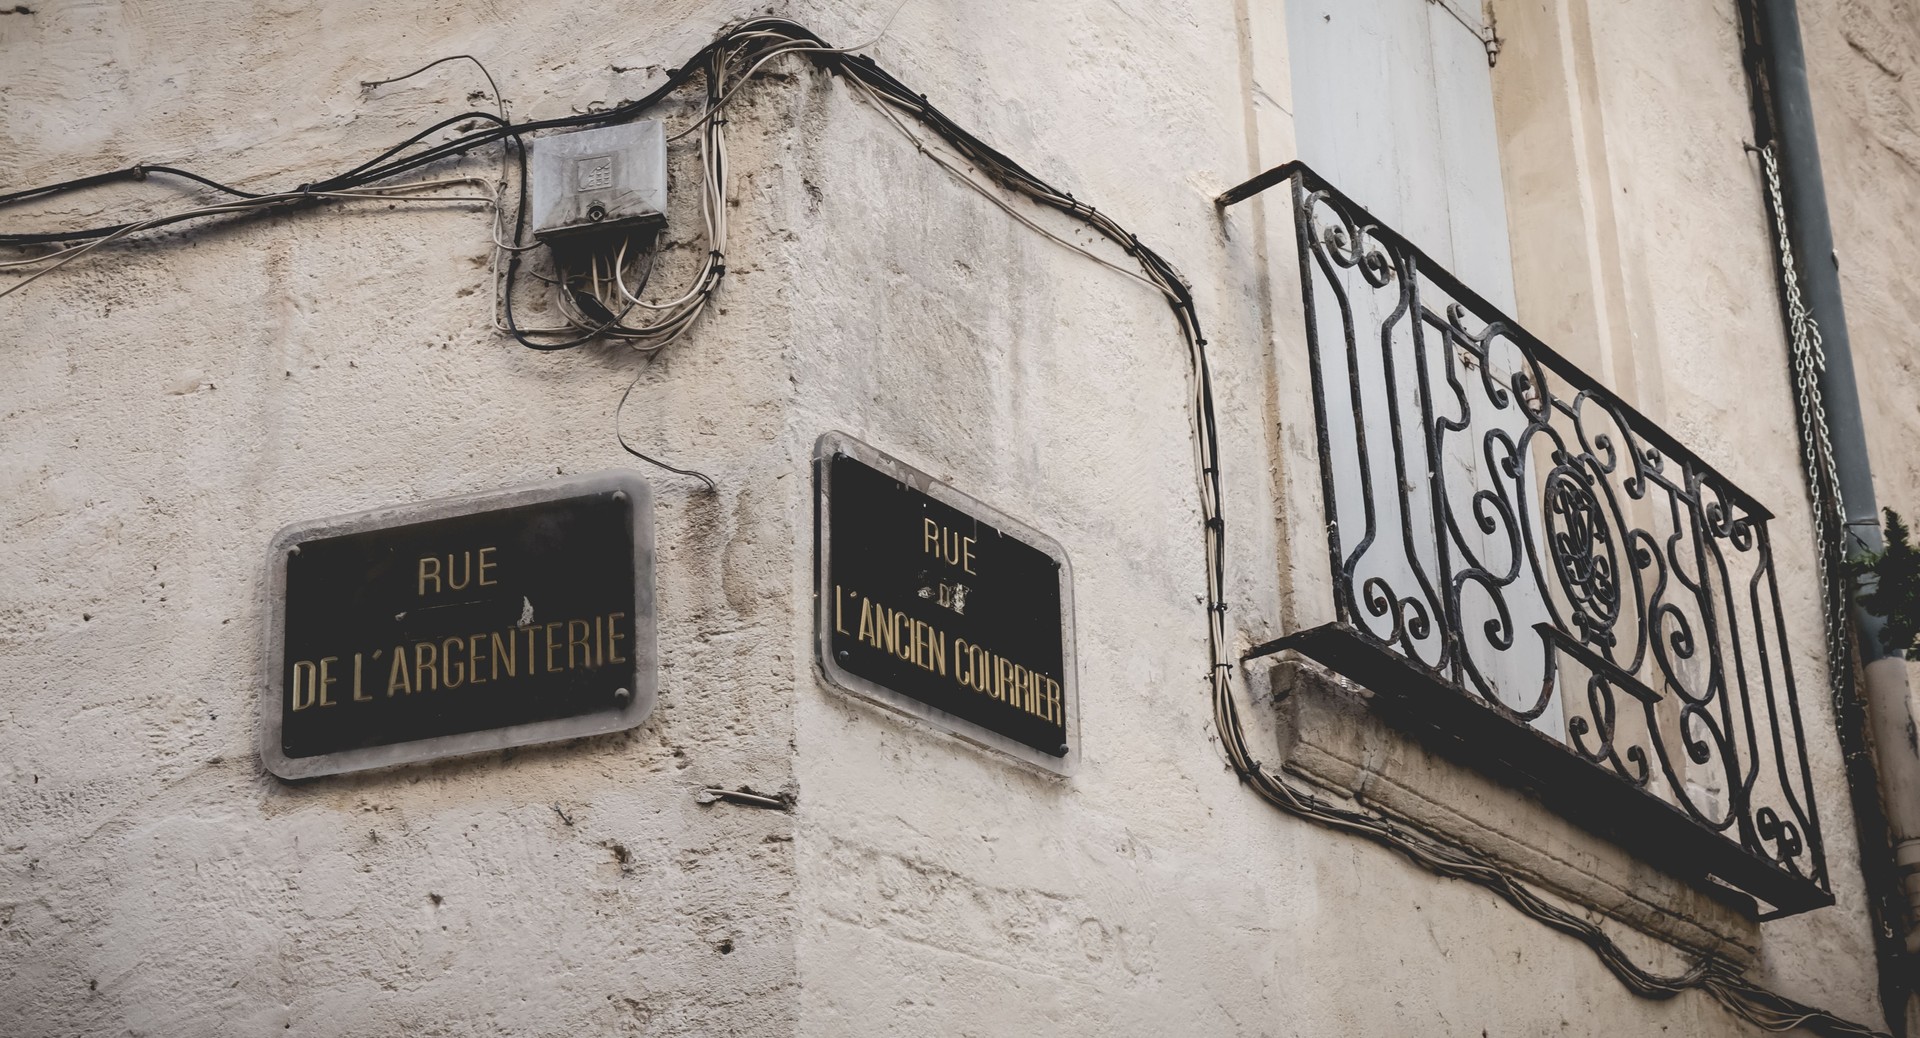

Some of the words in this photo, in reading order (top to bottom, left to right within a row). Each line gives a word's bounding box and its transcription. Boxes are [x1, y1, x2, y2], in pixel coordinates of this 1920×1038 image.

[419, 547, 498, 595] RUE
[924, 517, 977, 576] RUE
[292, 655, 339, 712] DE
[353, 612, 626, 702] L'ARGENTERIE
[836, 584, 946, 676] L'ANCIEN
[954, 637, 1062, 727] COURRIER
